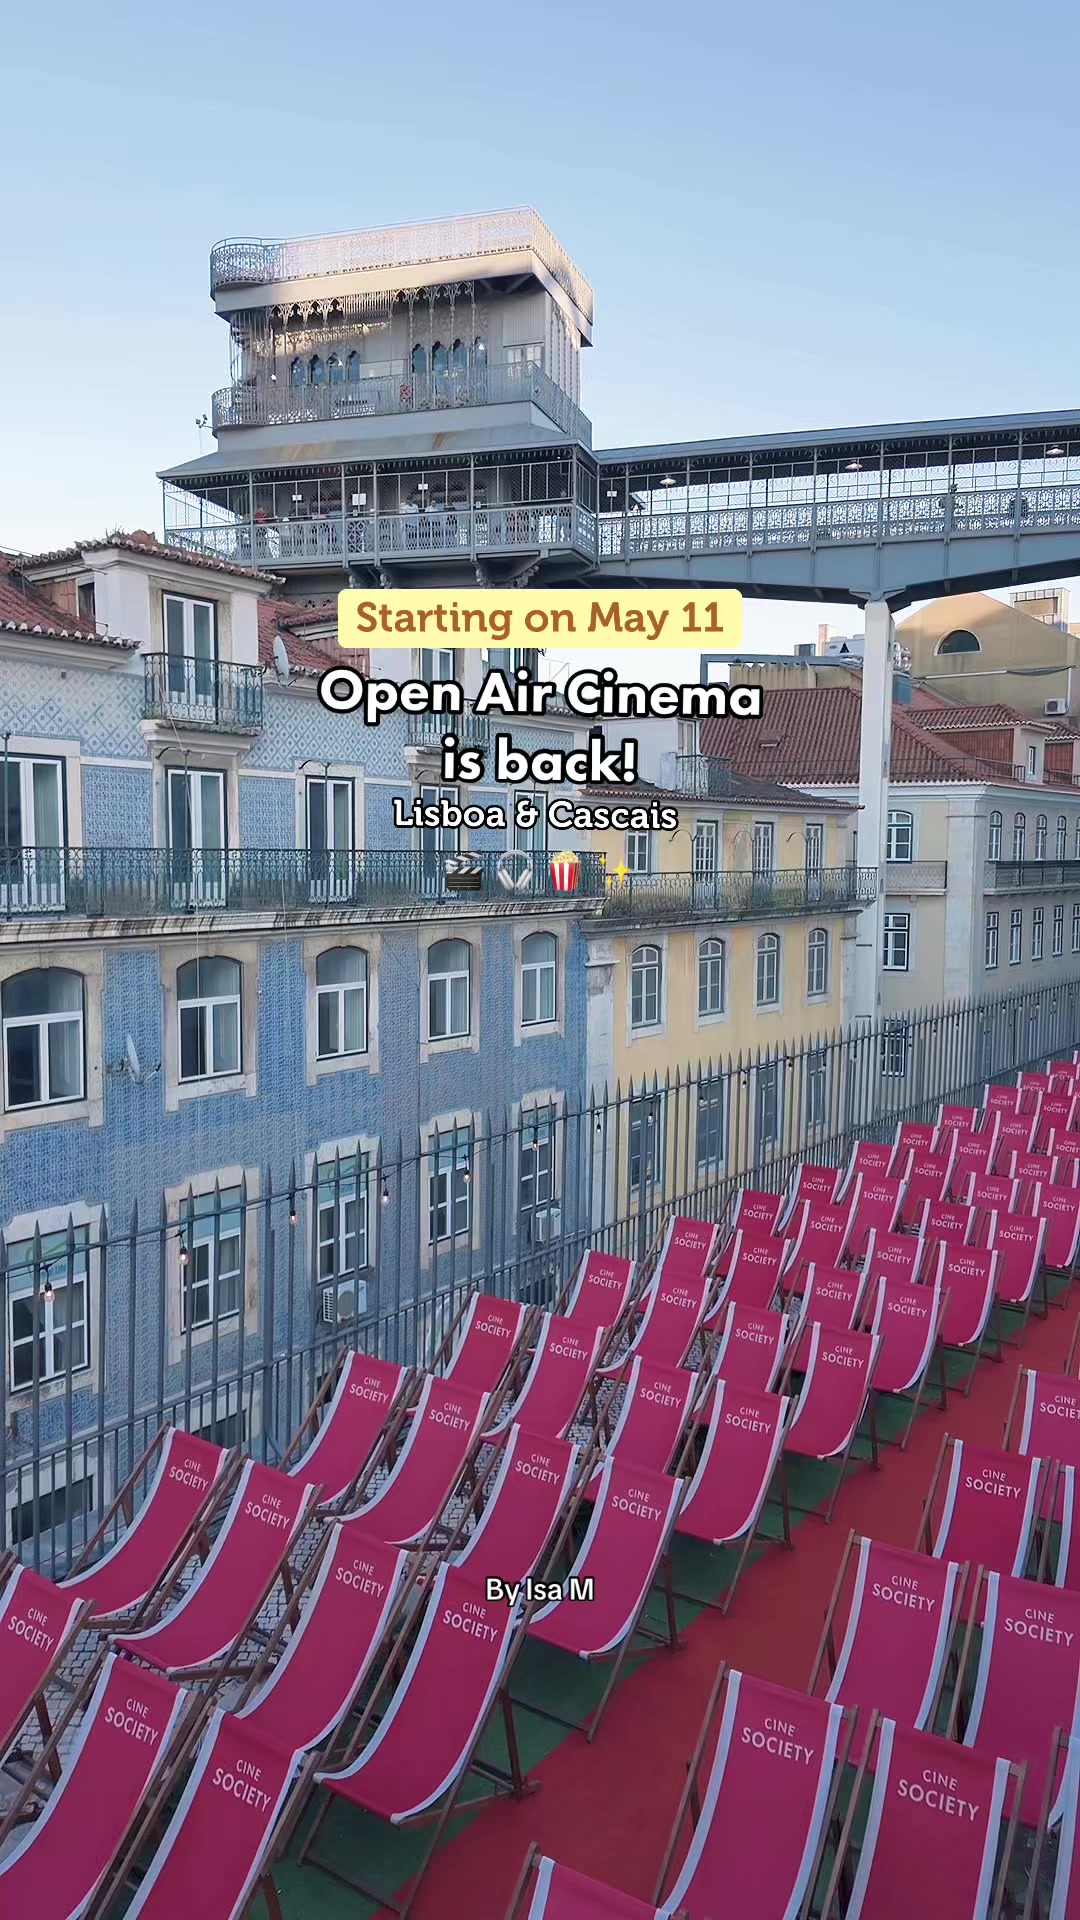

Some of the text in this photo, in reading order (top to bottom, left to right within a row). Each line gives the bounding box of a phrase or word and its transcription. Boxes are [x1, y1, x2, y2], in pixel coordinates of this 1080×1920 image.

[990, 1097, 1014, 1106] SOCIETY
[1043, 1105, 1069, 1114] SOCIETY
[944, 1119, 970, 1128] SOCIETY
[1001, 1126, 1029, 1136] SOCIETY
[902, 1137, 929, 1147] SOCIETY
[958, 1146, 988, 1156] SOCIETY
[859, 1157, 887, 1168] SOCIETY
[923, 1162, 937, 1170] CINE
[1027, 1162, 1040, 1170] CINE
[913, 1166, 944, 1178] SOCIETY
[1018, 1167, 1048, 1178] SOCIETY
[802, 1181, 832, 1192] SOCIETY
[811, 1176, 825, 1184] CINE
[872, 1186, 886, 1194] CINE
[976, 1190, 1008, 1201] SOCIETY
[986, 1185, 1000, 1193] CINE
[863, 1191, 894, 1203] SOCIETY
[1052, 1196, 1067, 1204] CINE
[752, 1203, 767, 1212] CINE
[1042, 1200, 1076, 1212] SOCIETY
[743, 1208, 774, 1221] SOCIETY
[820, 1215, 835, 1224] CINE
[940, 1213, 955, 1221] CINE
[810, 1220, 844, 1233] SOCIETY
[931, 1218, 964, 1230] SOCIETY
[1009, 1225, 1025, 1233] CINE
[684, 1231, 699, 1240] CINE
[999, 1230, 1034, 1242] SOCIETY
[674, 1236, 707, 1250] SOCIETY
[753, 1247, 769, 1256] CINE
[887, 1246, 903, 1255] CINE
[742, 1252, 778, 1266] SOCIETY
[876, 1250, 912, 1265] SOCIETY
[959, 1258, 975, 1267] CINE
[599, 1268, 615, 1279] CINE
[948, 1263, 986, 1277] SOCIETY
[587, 1274, 623, 1290] SOCIETY
[827, 1281, 844, 1290] CINE
[672, 1287, 689, 1297] CINE
[815, 1286, 853, 1302] SOCIETY
[660, 1292, 698, 1309] SOCIETY
[899, 1296, 917, 1306] CINE
[887, 1302, 928, 1318] SOCIETY
[487, 1314, 503, 1325] CINE
[475, 1320, 512, 1338] SOCIETY
[747, 1322, 765, 1333] CINE
[562, 1336, 579, 1347] CINE
[735, 1328, 775, 1345] SOCIETY
[549, 1342, 588, 1361] SOCIETY
[834, 1345, 853, 1356] CINE
[821, 1351, 865, 1369] SOCIETY
[363, 1376, 381, 1389] CINE
[653, 1381, 672, 1394] CINE
[349, 1383, 389, 1404] SOCIETY
[639, 1387, 682, 1408] SOCIETY
[1054, 1394, 1078, 1407] CINE
[443, 1402, 462, 1415] CINE
[739, 1406, 760, 1419] CINE
[428, 1409, 471, 1432] SOCIETY
[724, 1413, 772, 1434] SOCIETY
[184, 1458, 201, 1473] CINE
[531, 1453, 551, 1467] CINE
[168, 1465, 209, 1492] SOCIETY
[515, 1460, 561, 1485] SOCIETY
[982, 1468, 1007, 1482] CINE
[965, 1476, 1021, 1499] SOCIETY
[262, 1494, 282, 1510] CINE
[628, 1488, 650, 1503] CINE
[611, 1495, 662, 1521] SOCIETY
[244, 1501, 291, 1529] SOCIETY
[353, 1559, 375, 1576] CINE
[335, 1567, 385, 1598] SOCIETY
[891, 1575, 919, 1591] CINE
[872, 1583, 936, 1612] SOCIETY
[27, 1607, 48, 1627] CINE
[462, 1602, 487, 1620] CINE
[1024, 1608, 1055, 1624] CINE
[442, 1609, 498, 1642] SOCIETY
[1004, 1617, 1074, 1647] SOCIETY
[7, 1615, 55, 1652] SOCIETY
[126, 1698, 149, 1719] CINE
[104, 1706, 159, 1746] SOCIETY
[764, 1717, 796, 1737] CINE
[741, 1726, 815, 1765] SOCIETY
[236, 1759, 262, 1782] CINE
[922, 1769, 958, 1792] CINE
[212, 1767, 272, 1812] SOCIETY
[897, 1778, 980, 1822] SOCIETY
